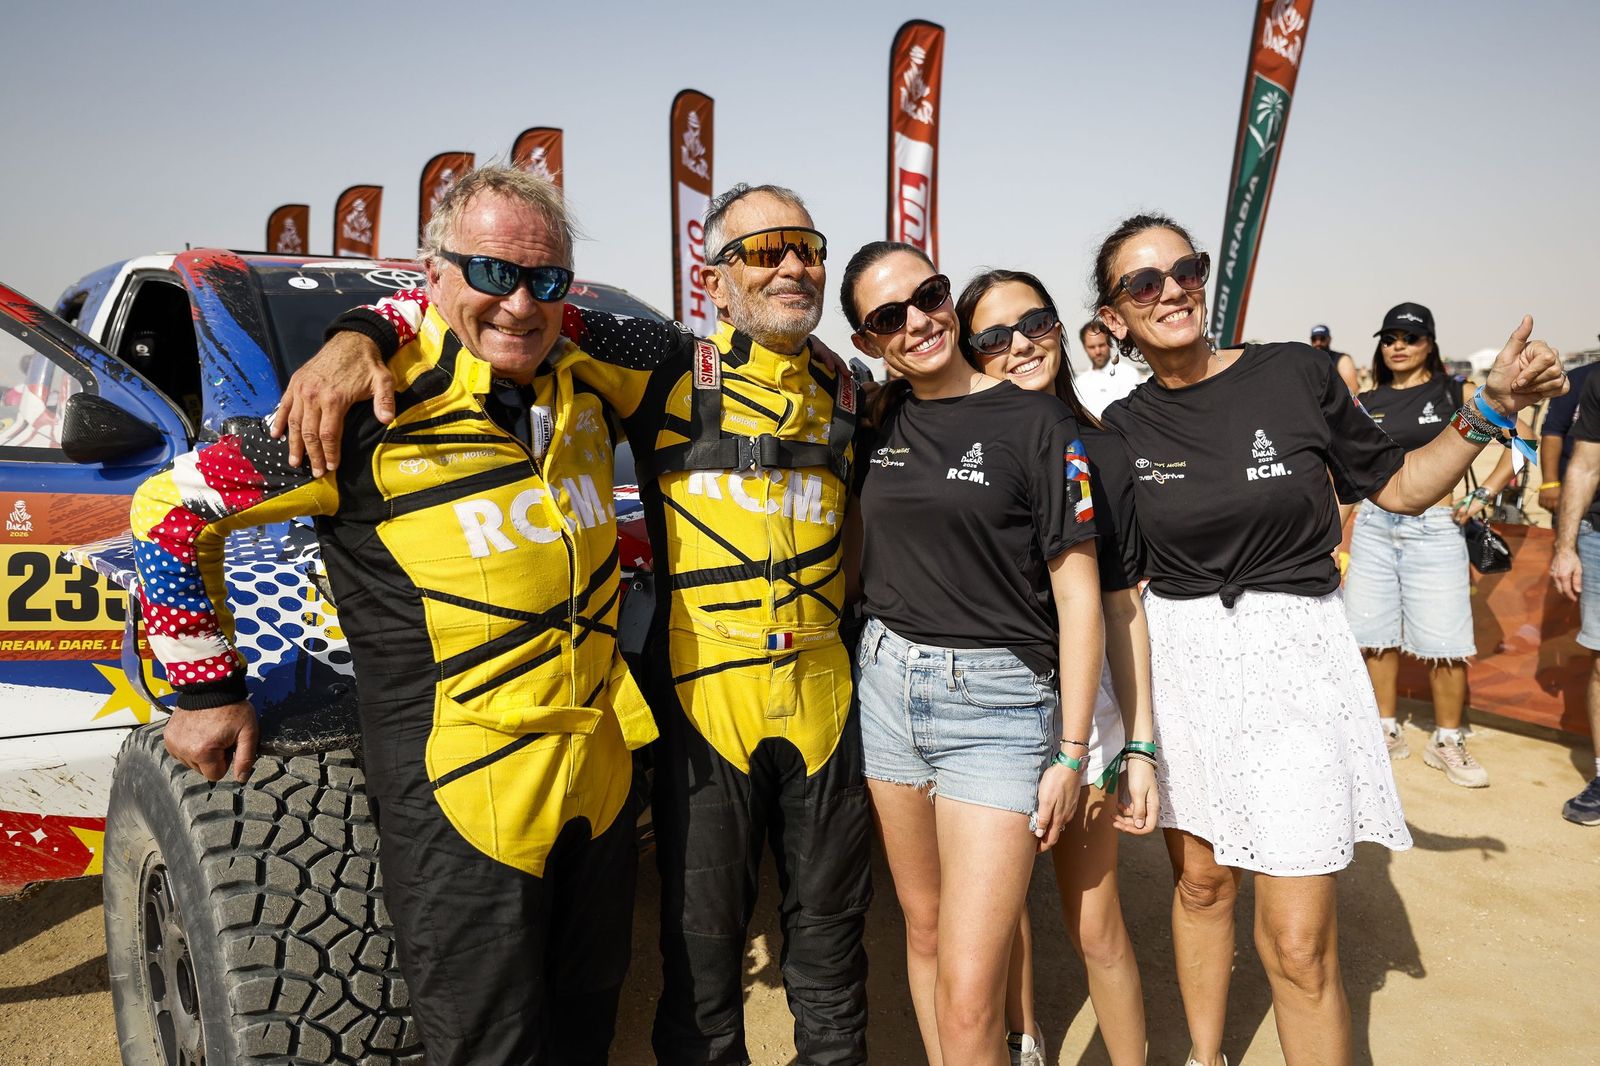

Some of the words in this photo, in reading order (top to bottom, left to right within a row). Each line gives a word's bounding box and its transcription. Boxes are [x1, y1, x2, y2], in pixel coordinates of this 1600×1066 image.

[1212, 286, 1231, 349] AUDI
[1225, 174, 1260, 281] ARABIA
[700, 343, 713, 385] SIMPSON
[1251, 447, 1277, 458] DAKAR
[946, 468, 991, 487] RCM.
[1246, 463, 1292, 481] RCM.
[5, 520, 33, 531] DAKAR
[453, 474, 617, 559] RCM.
[0, 640, 55, 651] REAM.
[58, 640, 108, 651] DARE.
[111, 640, 147, 651] LE
